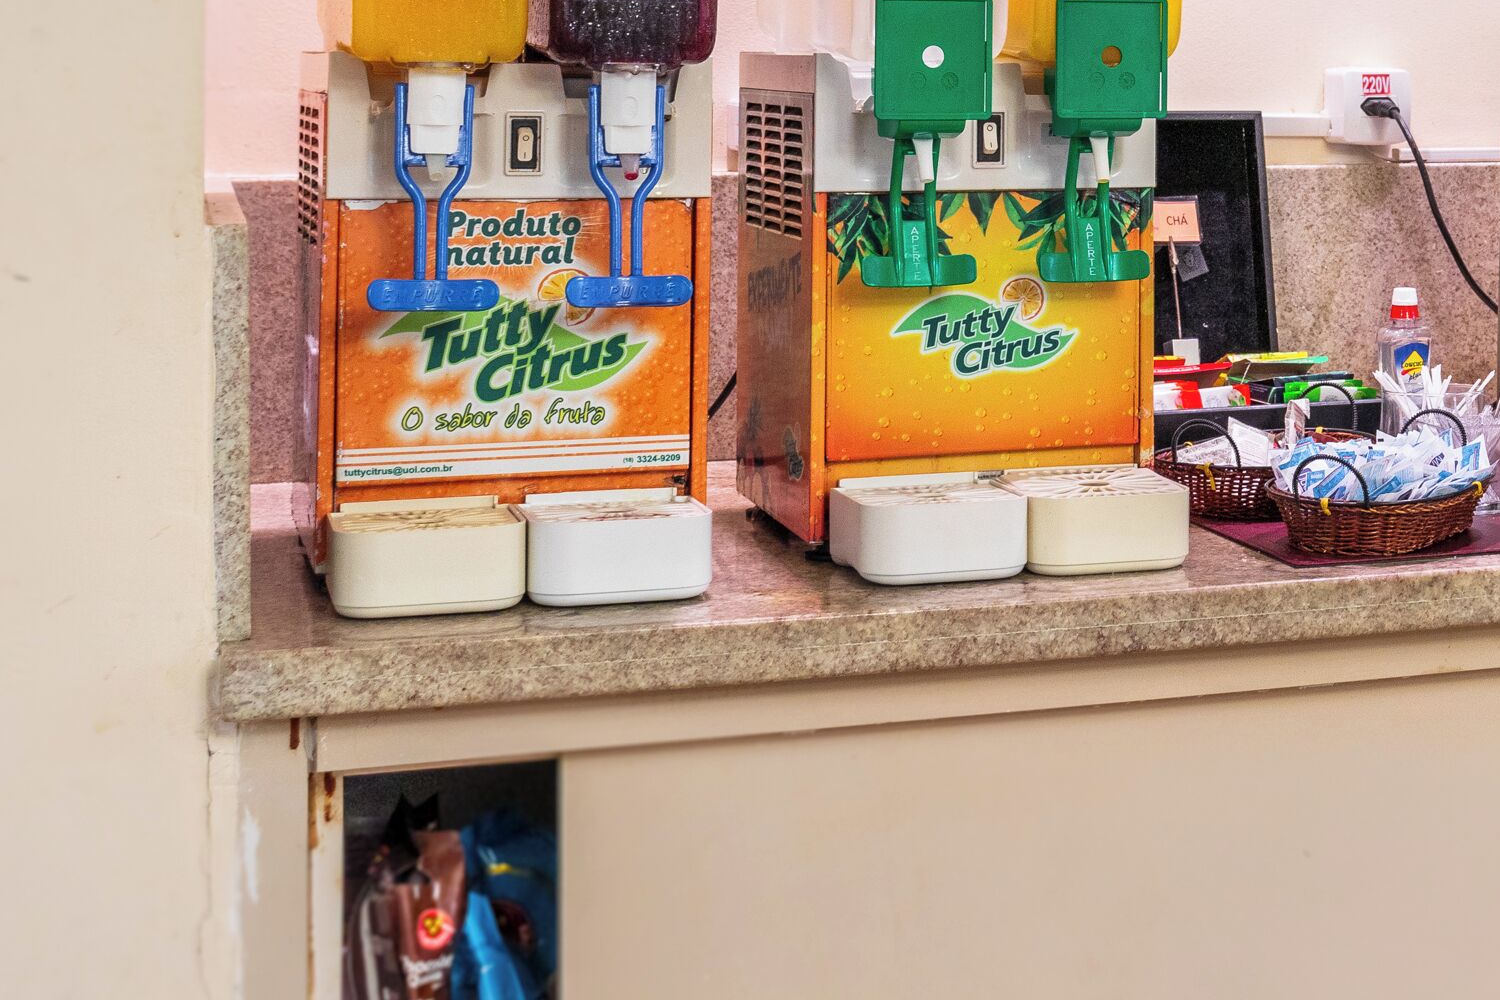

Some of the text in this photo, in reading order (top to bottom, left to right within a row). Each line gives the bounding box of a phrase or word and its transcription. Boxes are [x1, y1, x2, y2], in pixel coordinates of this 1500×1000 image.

[1363, 76, 1390, 93] 220V
[448, 208, 582, 237] Produto
[1166, 213, 1188, 226] CHÁ
[447, 237, 576, 267] natural
[910, 226, 922, 281] APERTE
[1084, 222, 1097, 276] APERTE
[421, 300, 562, 374] Tutty
[922, 303, 1019, 349] Tutty
[475, 332, 629, 402] Citrus
[953, 329, 1061, 375] Citrus
[401, 398, 606, 432] O sabor da fruta
[344, 464, 454, 478] tuttycitrus@uol.com.br
[636, 453, 681, 464] 3324-9209
